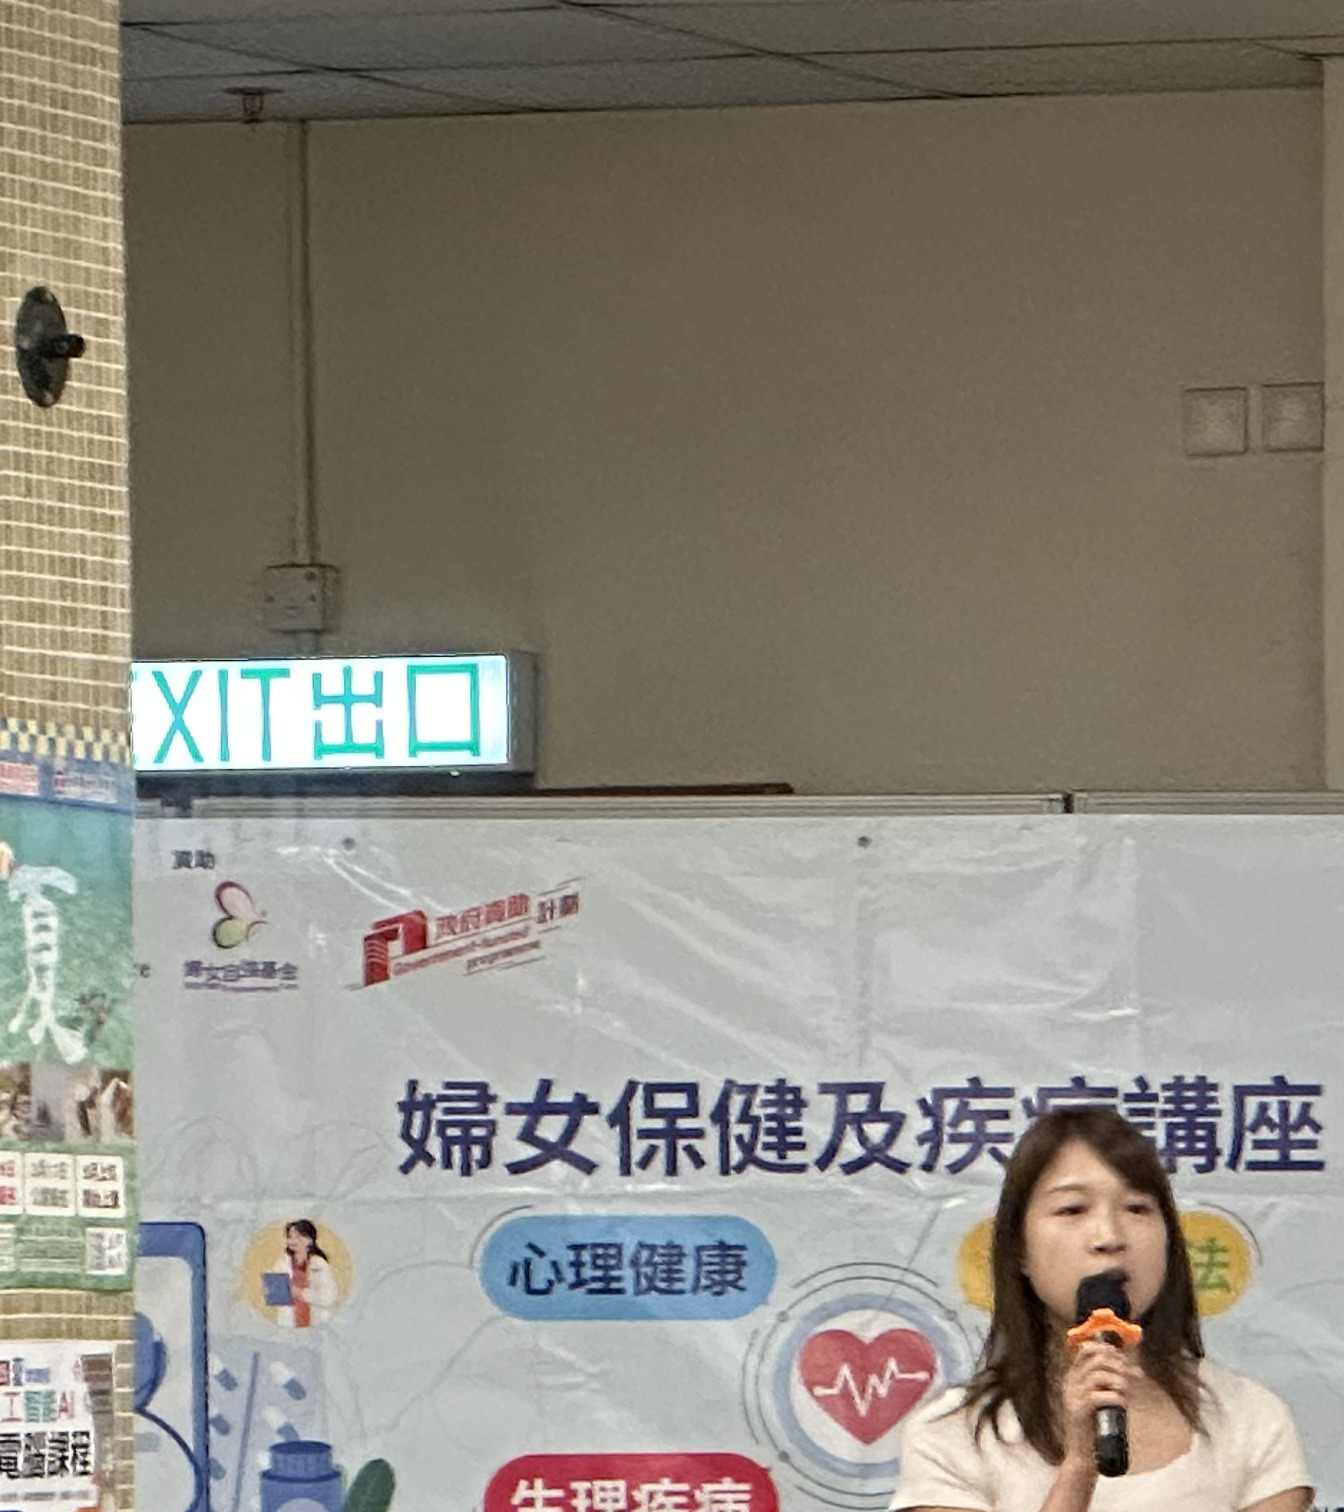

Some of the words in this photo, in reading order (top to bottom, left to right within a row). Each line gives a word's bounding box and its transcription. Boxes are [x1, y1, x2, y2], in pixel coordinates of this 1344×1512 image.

[132, 668, 291, 764] XIT
[311, 662, 481, 761] 出口
[506, 1240, 748, 1296] 心理健康
